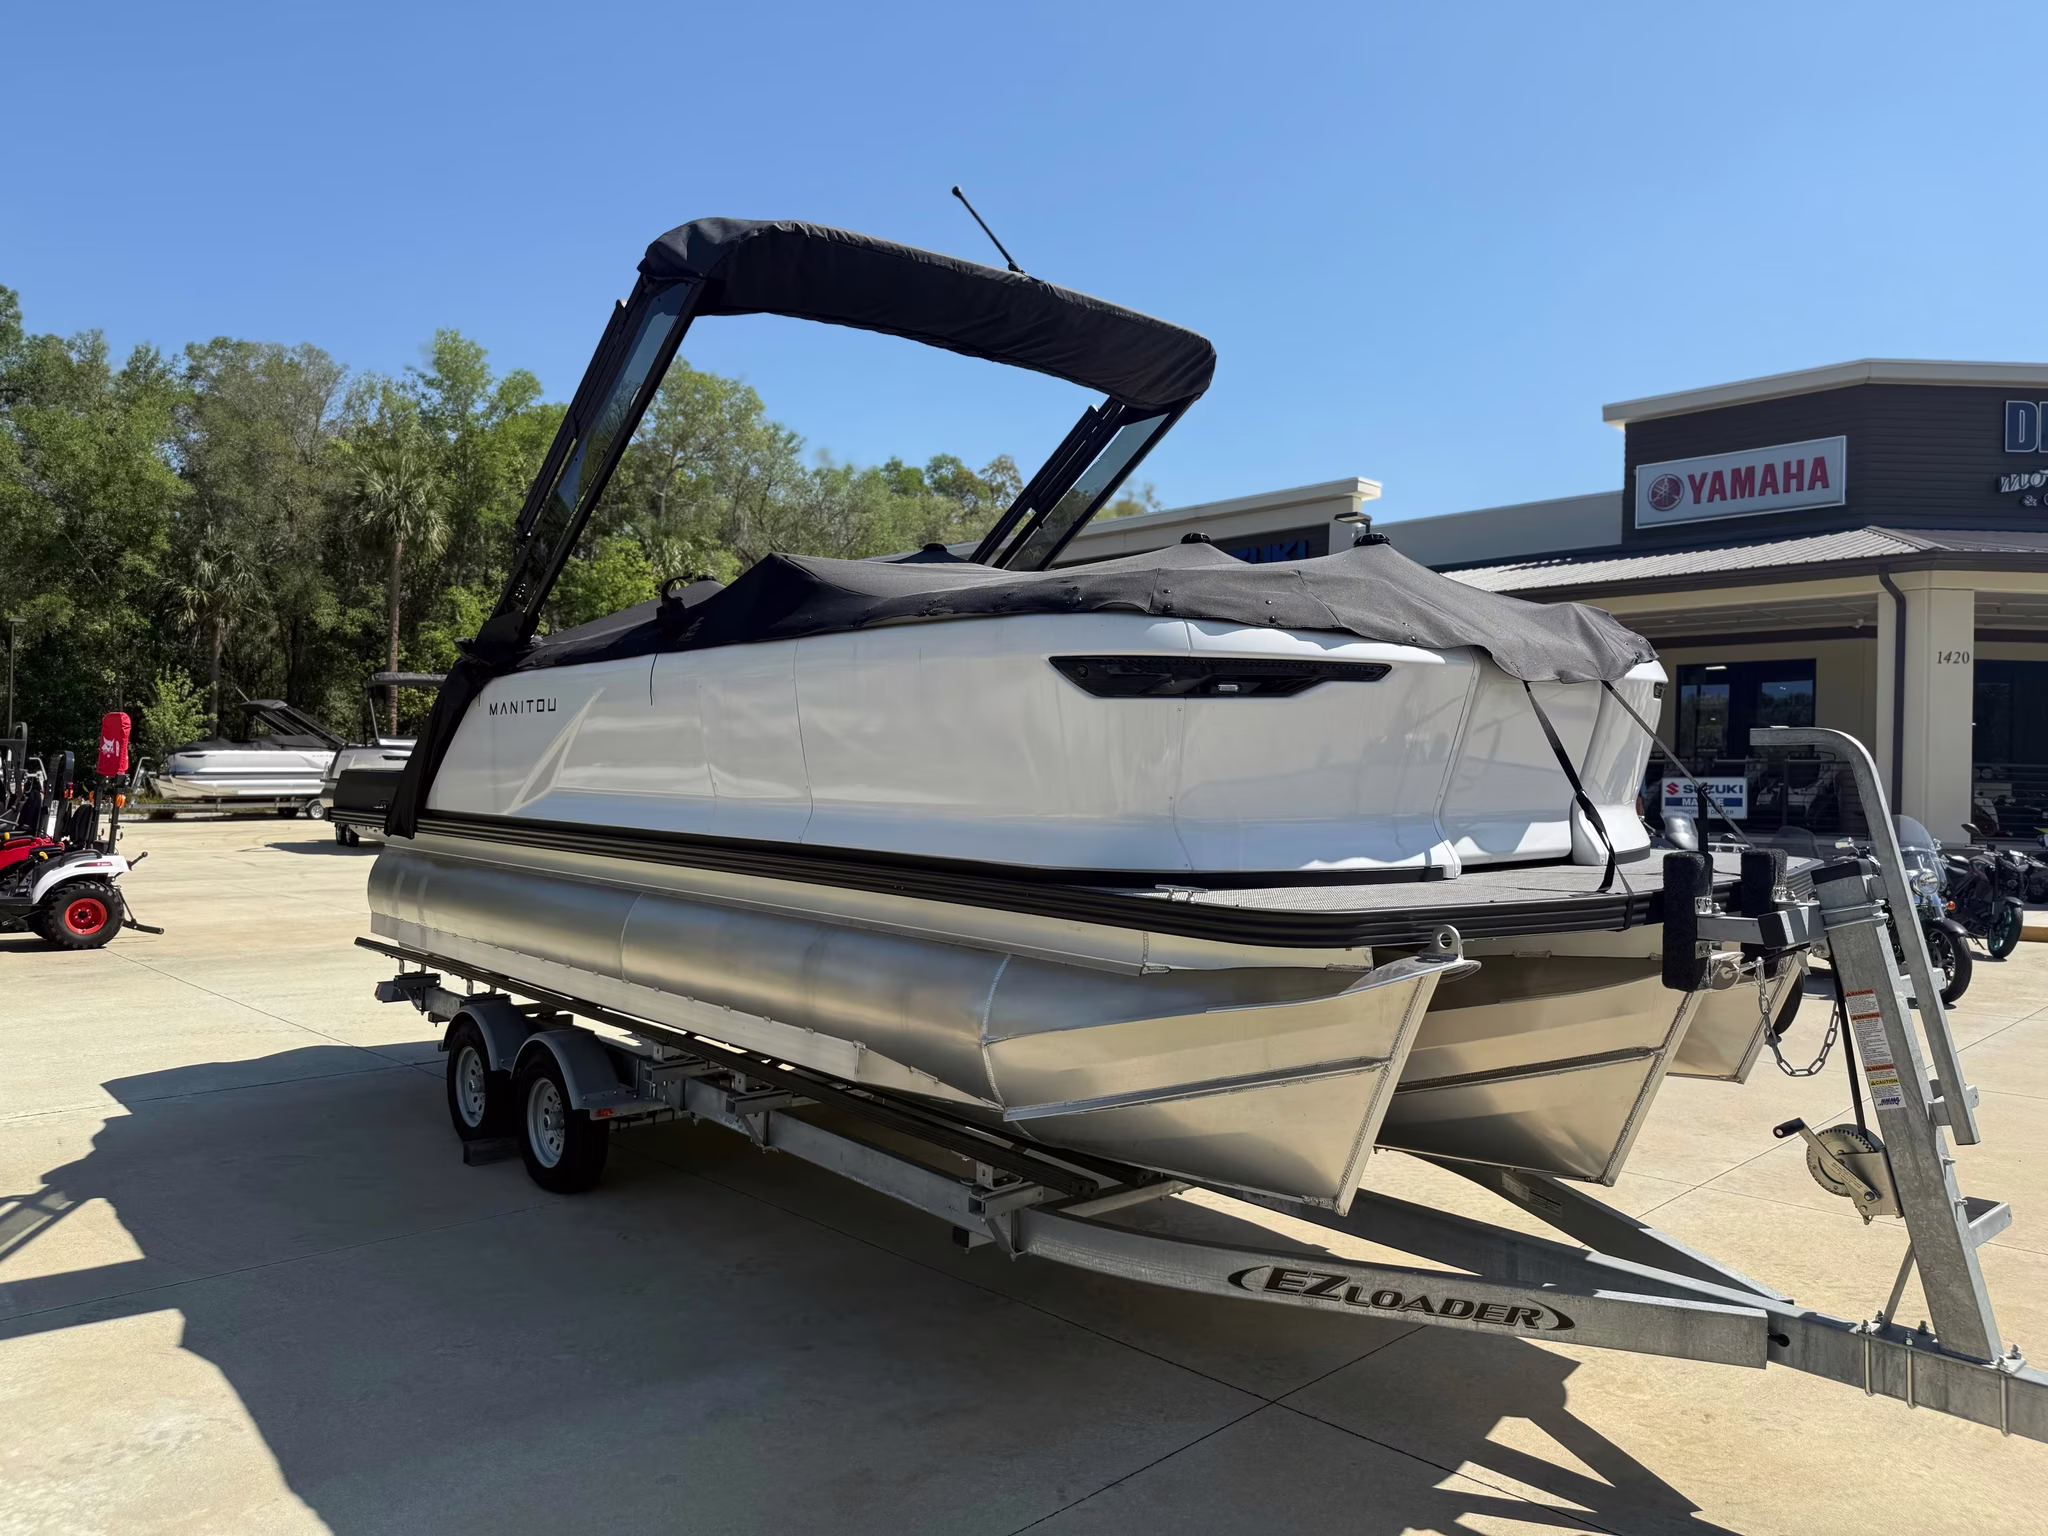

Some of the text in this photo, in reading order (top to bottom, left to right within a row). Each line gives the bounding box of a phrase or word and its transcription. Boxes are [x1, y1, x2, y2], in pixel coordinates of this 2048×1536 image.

[1687, 456, 1830, 504] YAMAHA
[1937, 651, 1970, 664] 1420
[489, 698, 557, 716] MANITOU
